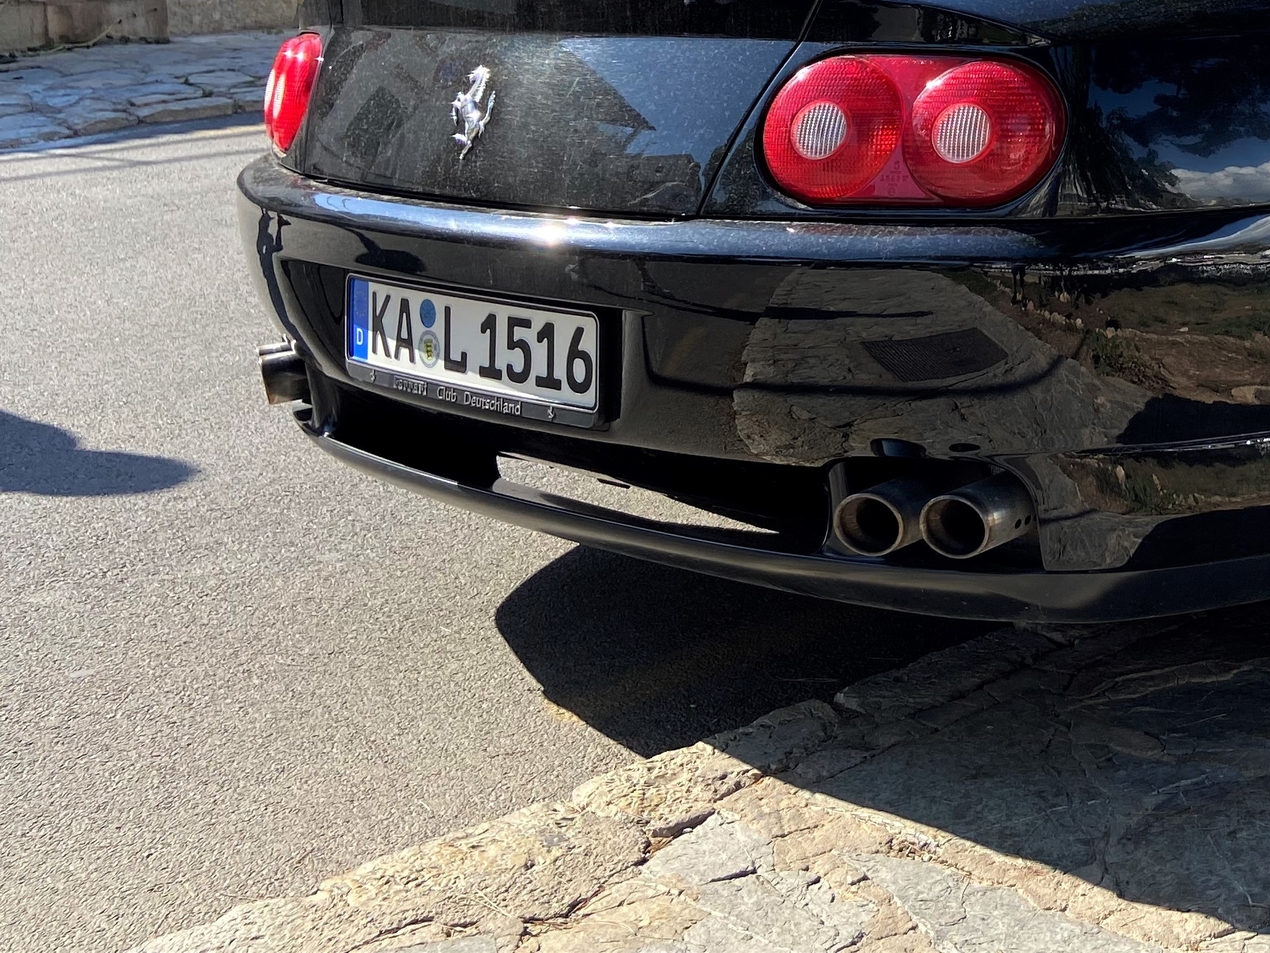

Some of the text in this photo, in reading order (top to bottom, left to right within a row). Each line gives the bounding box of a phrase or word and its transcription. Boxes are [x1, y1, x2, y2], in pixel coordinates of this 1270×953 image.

[356, 328, 364, 345] D
[372, 291, 593, 394] KA L 1516
[437, 386, 458, 403] Club
[463, 391, 521, 416] Deutschland
